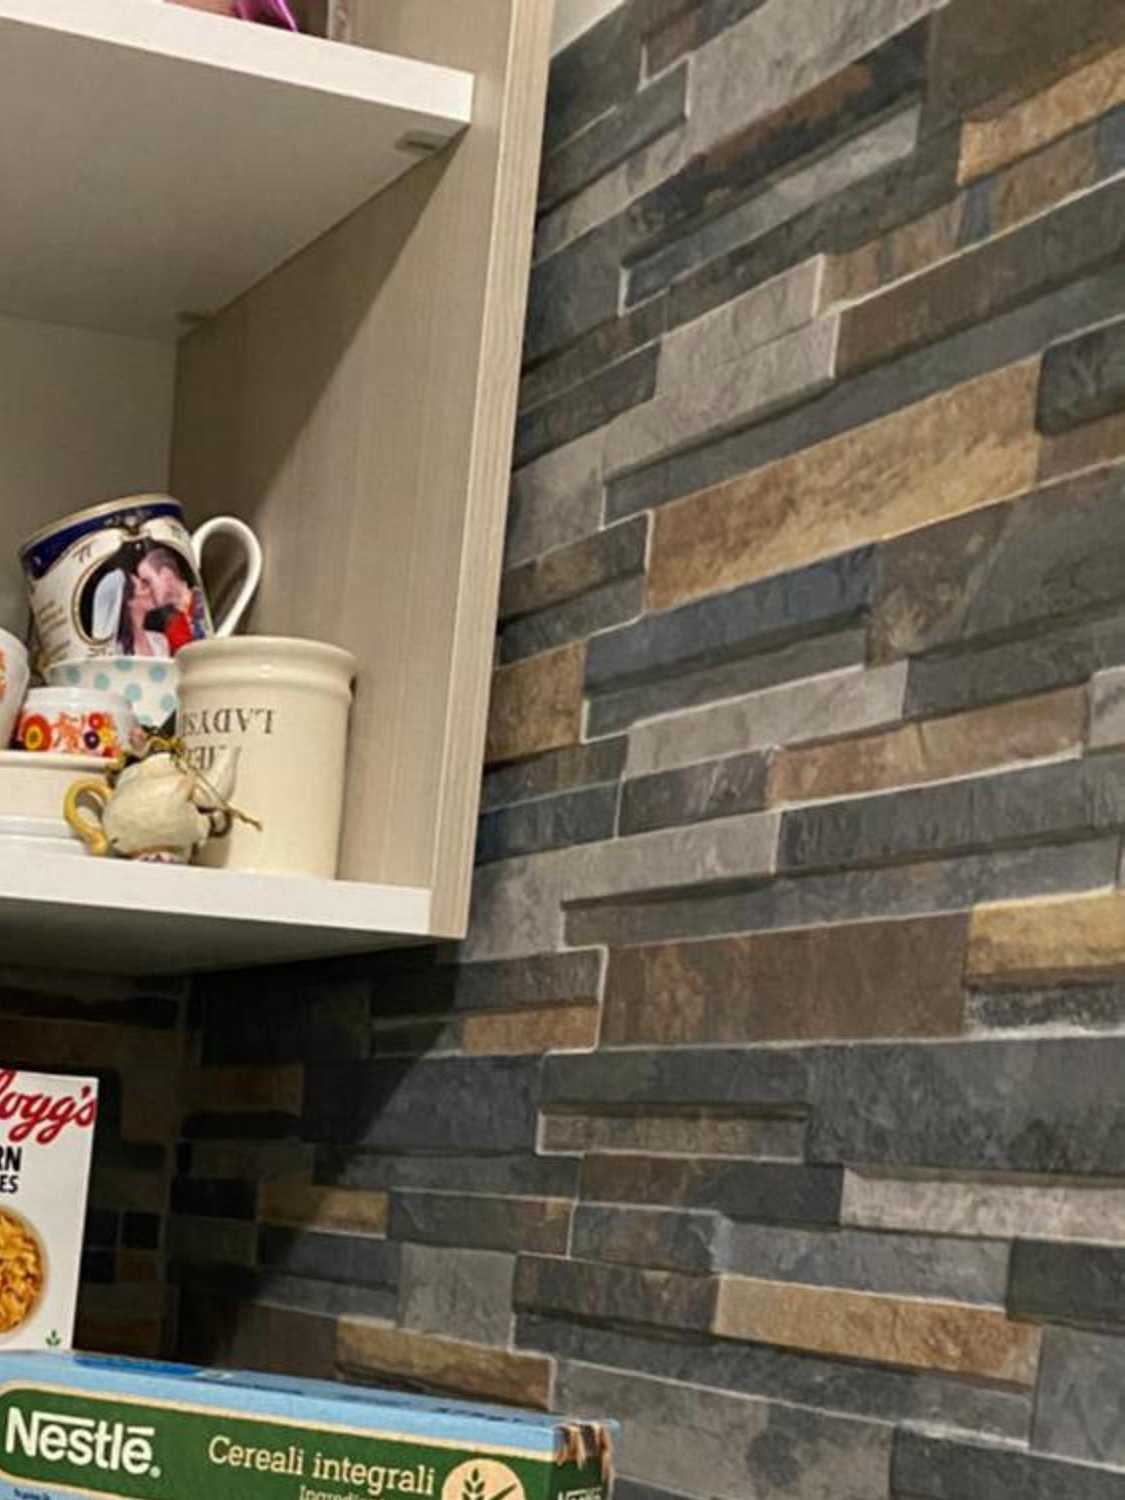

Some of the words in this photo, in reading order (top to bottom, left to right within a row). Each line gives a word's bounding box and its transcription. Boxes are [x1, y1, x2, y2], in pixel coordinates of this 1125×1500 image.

[181, 708, 276, 737] LADYS
[208, 1435, 304, 1476] Cereali
[312, 1452, 435, 1496] integrali
